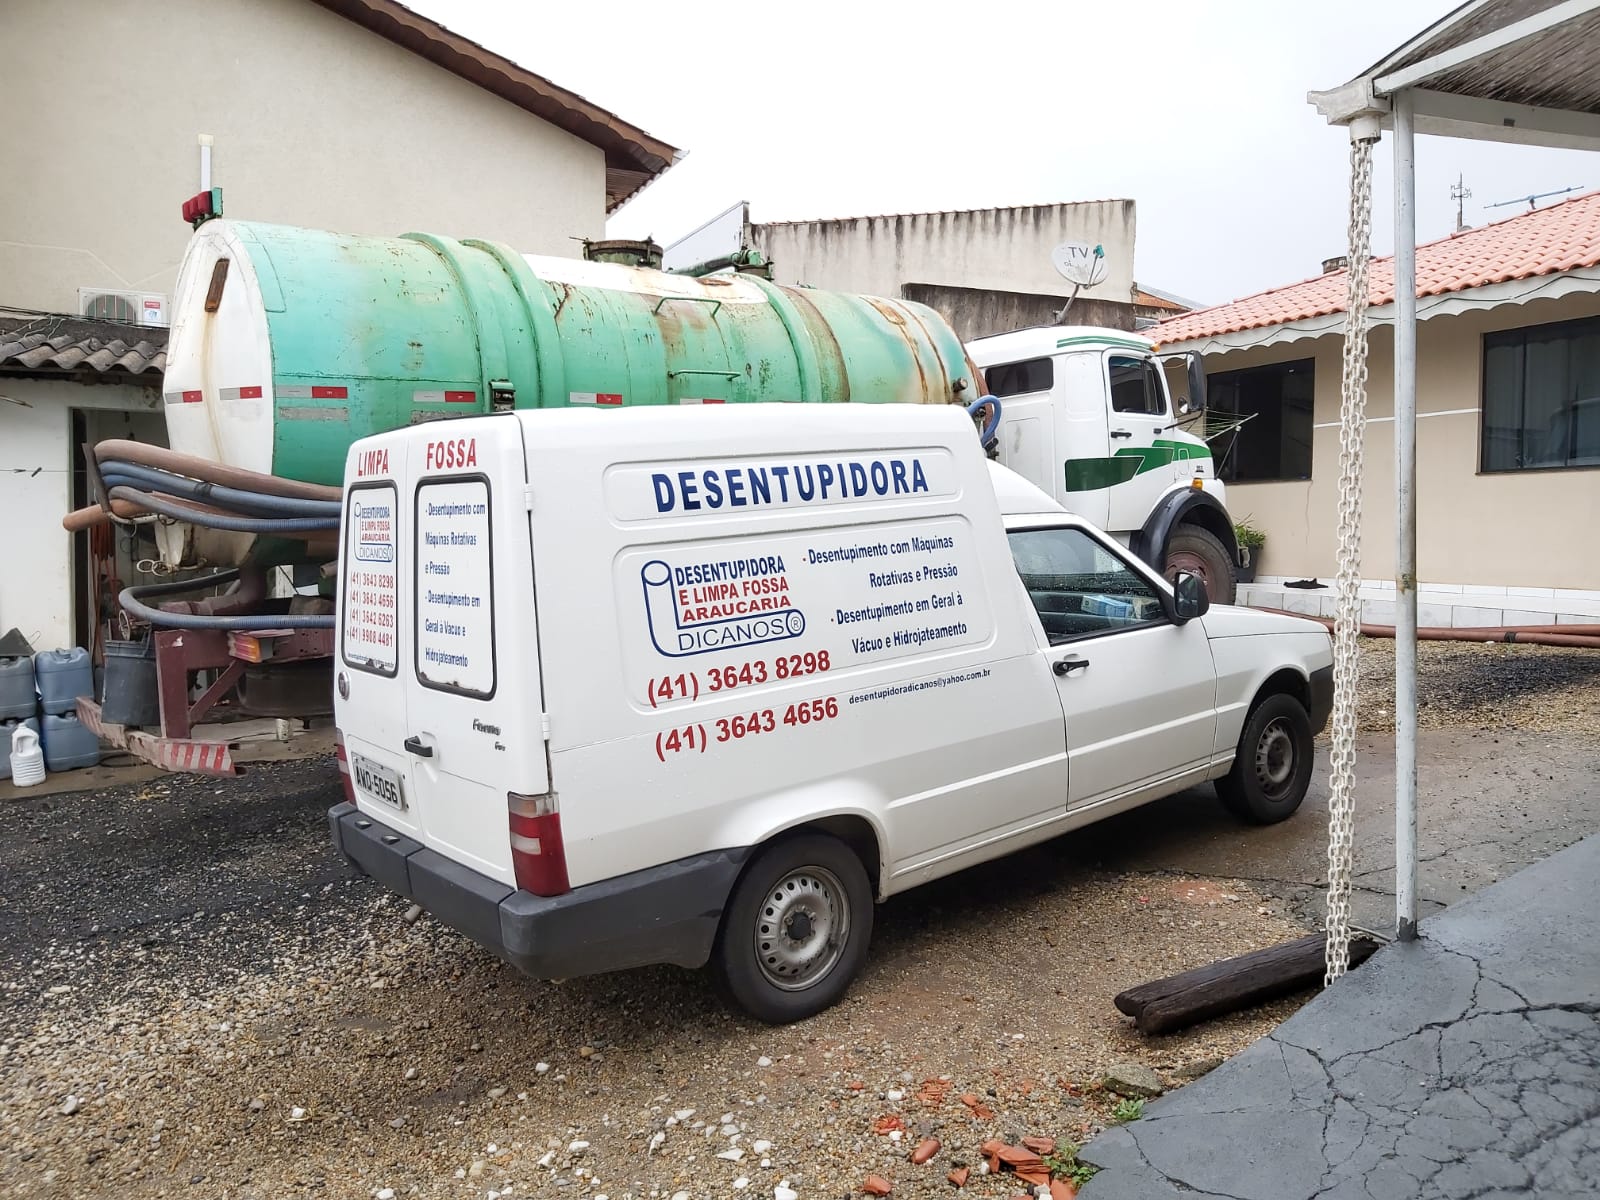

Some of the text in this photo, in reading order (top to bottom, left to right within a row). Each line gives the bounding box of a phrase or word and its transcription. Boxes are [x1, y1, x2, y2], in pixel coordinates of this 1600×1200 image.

[1067, 246, 1088, 258] TV
[358, 438, 477, 476] LIMPA FOSSA
[651, 459, 929, 513] DESENTUPIDORA
[428, 502, 486, 518] Desentupimento com
[450, 531, 477, 546] Rotativas
[808, 535, 954, 564] Desentupimento com Máquinas
[351, 571, 361, 588] (41)
[378, 574, 394, 589] 8298
[429, 561, 451, 575] Pressão
[675, 555, 786, 586] DESENTUPIDORA
[869, 563, 958, 588] Rotativas e Pressão
[350, 590, 360, 607] (41)
[378, 593, 394, 608] 4656
[428, 589, 481, 608] Desentupimento em
[679, 576, 790, 606] E LIMPA FOSSA
[350, 608, 360, 625] (41)
[682, 595, 792, 622] ARAUCARIA
[836, 600, 913, 625] Desentupimento
[916, 599, 930, 612] em
[931, 592, 955, 609] Geral
[425, 618, 439, 633] Geral
[678, 618, 785, 651] DICANOS
[852, 621, 967, 654] Vácuo e Hidrojateamento
[425, 647, 469, 667] Hidrojateamento
[648, 650, 831, 708] (41) 3643 8298
[849, 668, 991, 704] desentupidoradicanos@yahoo.com.br
[655, 697, 839, 762] (41) 3643 4656
